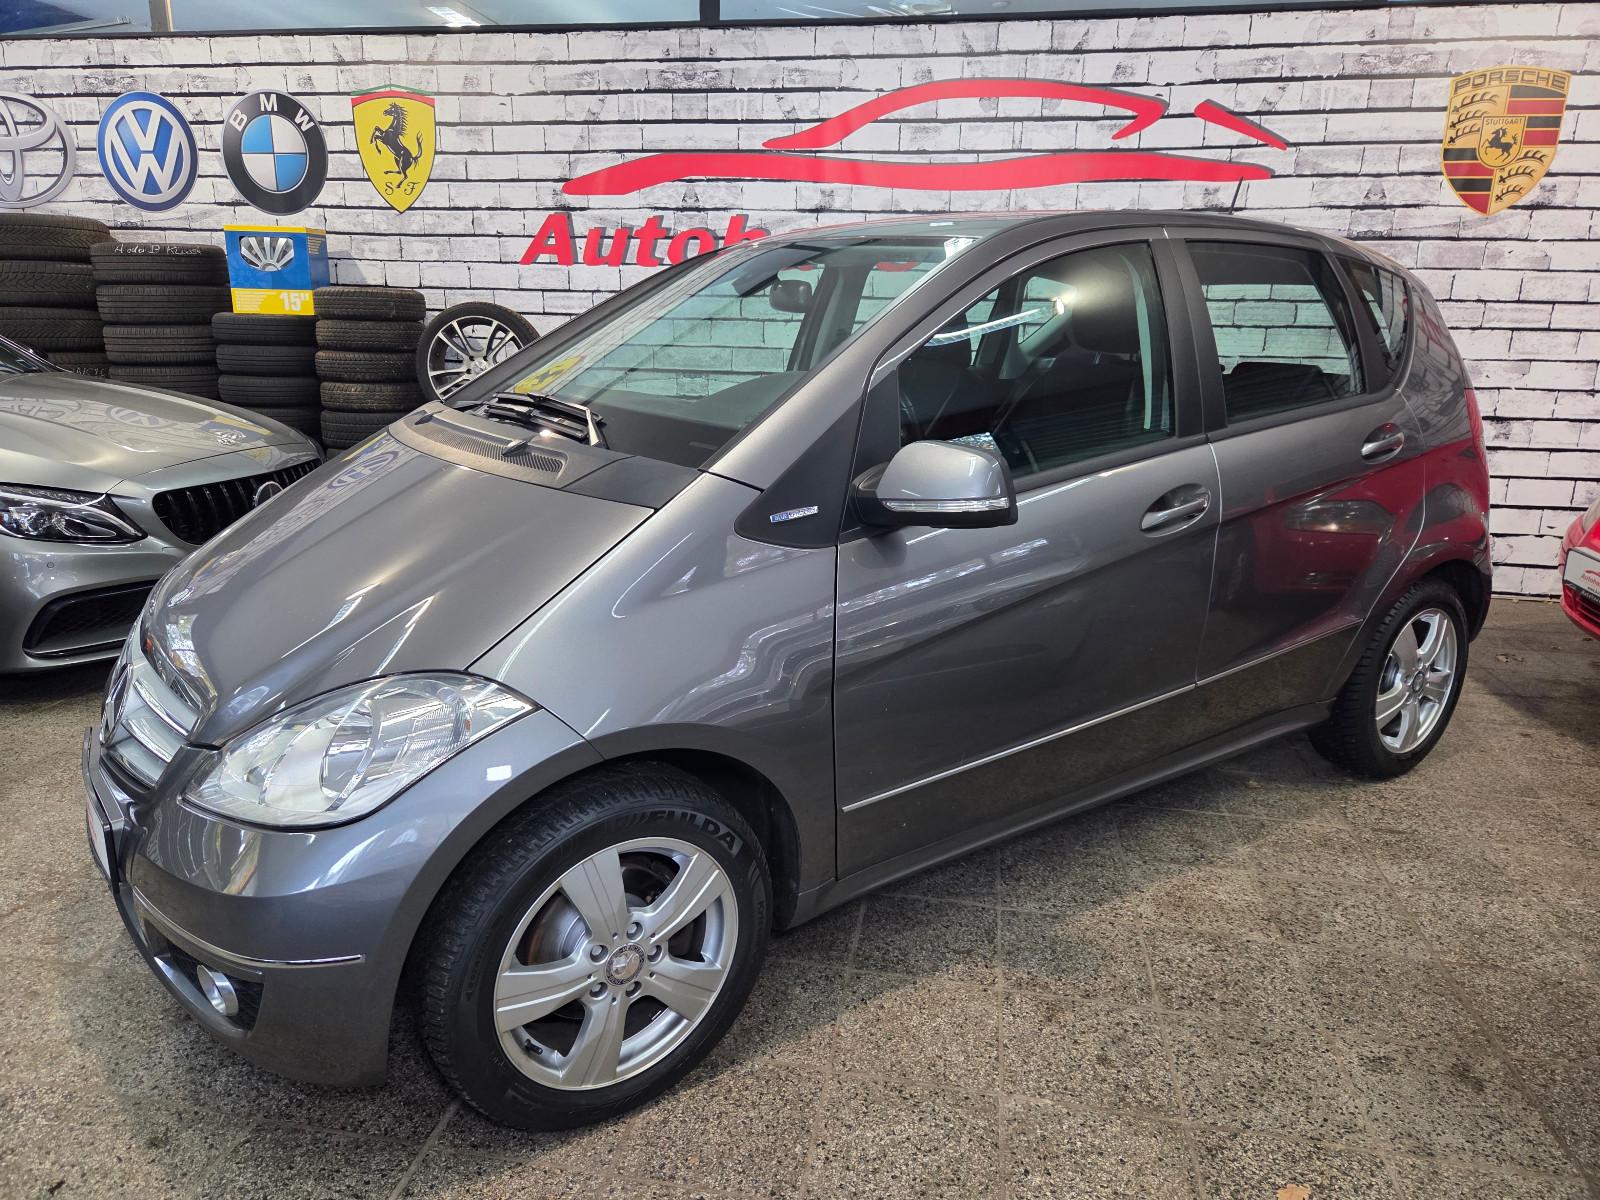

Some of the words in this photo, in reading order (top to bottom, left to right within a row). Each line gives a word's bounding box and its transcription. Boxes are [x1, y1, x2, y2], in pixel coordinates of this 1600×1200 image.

[1454, 70, 1567, 94] PORSCHE
[231, 93, 314, 133] BMW
[1485, 118, 1523, 126] STUTTGART
[519, 212, 771, 268] Autoh
[649, 809, 737, 852] FULDA
